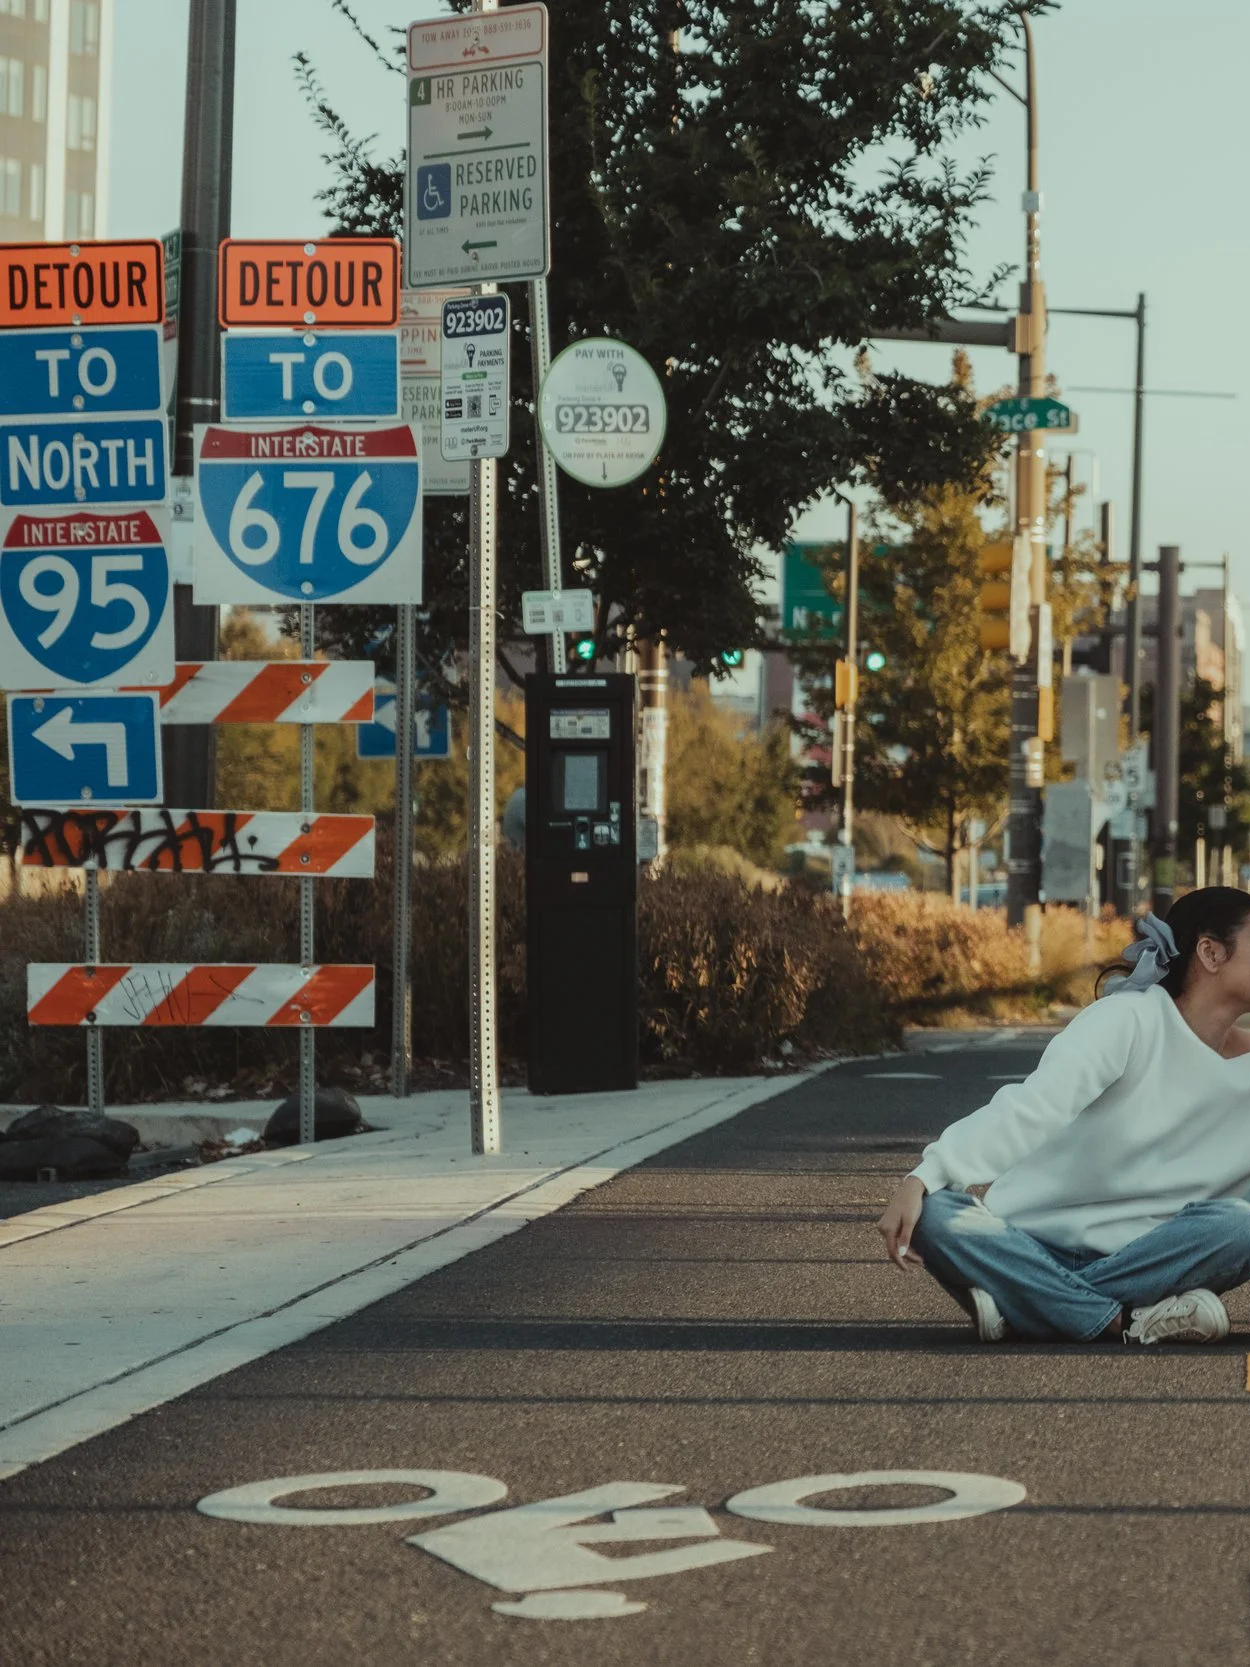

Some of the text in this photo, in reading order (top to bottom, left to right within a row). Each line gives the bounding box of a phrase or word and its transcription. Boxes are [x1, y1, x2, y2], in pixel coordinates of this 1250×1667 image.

[421, 32, 437, 43] TOW
[440, 30, 460, 41] AWAY
[417, 69, 524, 101] 4 HR PARKING
[456, 154, 537, 187] RESERVED
[459, 187, 533, 217] PARKING
[8, 261, 148, 310] DETOUR
[239, 261, 384, 307] DETOUR
[401, 327, 438, 344] PPIN
[446, 307, 503, 335] 923902
[477, 358, 504, 367] PAYMENTS
[480, 348, 502, 357] PARKING
[575, 349, 624, 359] PAY WITH
[35, 347, 118, 398] TO
[269, 352, 354, 400] TO
[559, 406, 648, 433] 923902
[1046, 408, 1067, 428] St
[251, 436, 366, 456] INTERSTATE
[8, 435, 155, 491] NORTH
[23, 520, 142, 544] INTERSTATE
[228, 470, 389, 566] 676
[18, 554, 151, 651] 95
